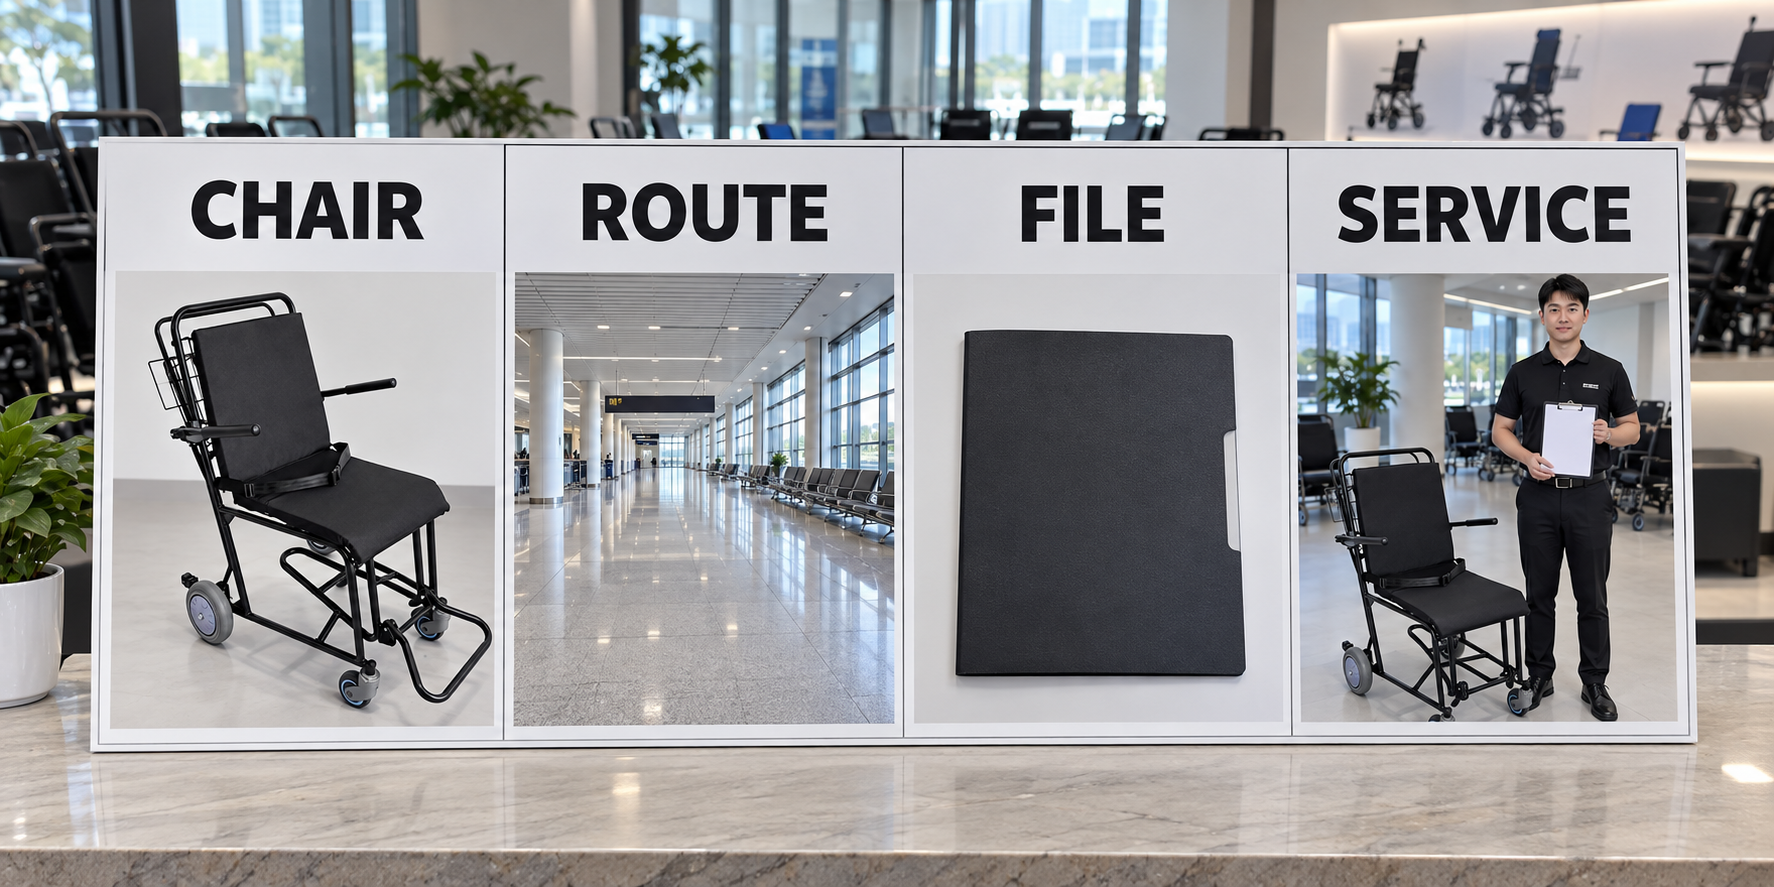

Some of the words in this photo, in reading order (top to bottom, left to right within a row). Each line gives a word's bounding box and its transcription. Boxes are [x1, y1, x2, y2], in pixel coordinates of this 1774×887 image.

[191, 180, 424, 240] CHAIR
[583, 183, 827, 242] ROUTE
[1022, 185, 1165, 242] FILE
[1338, 185, 1631, 243] SERVICE
